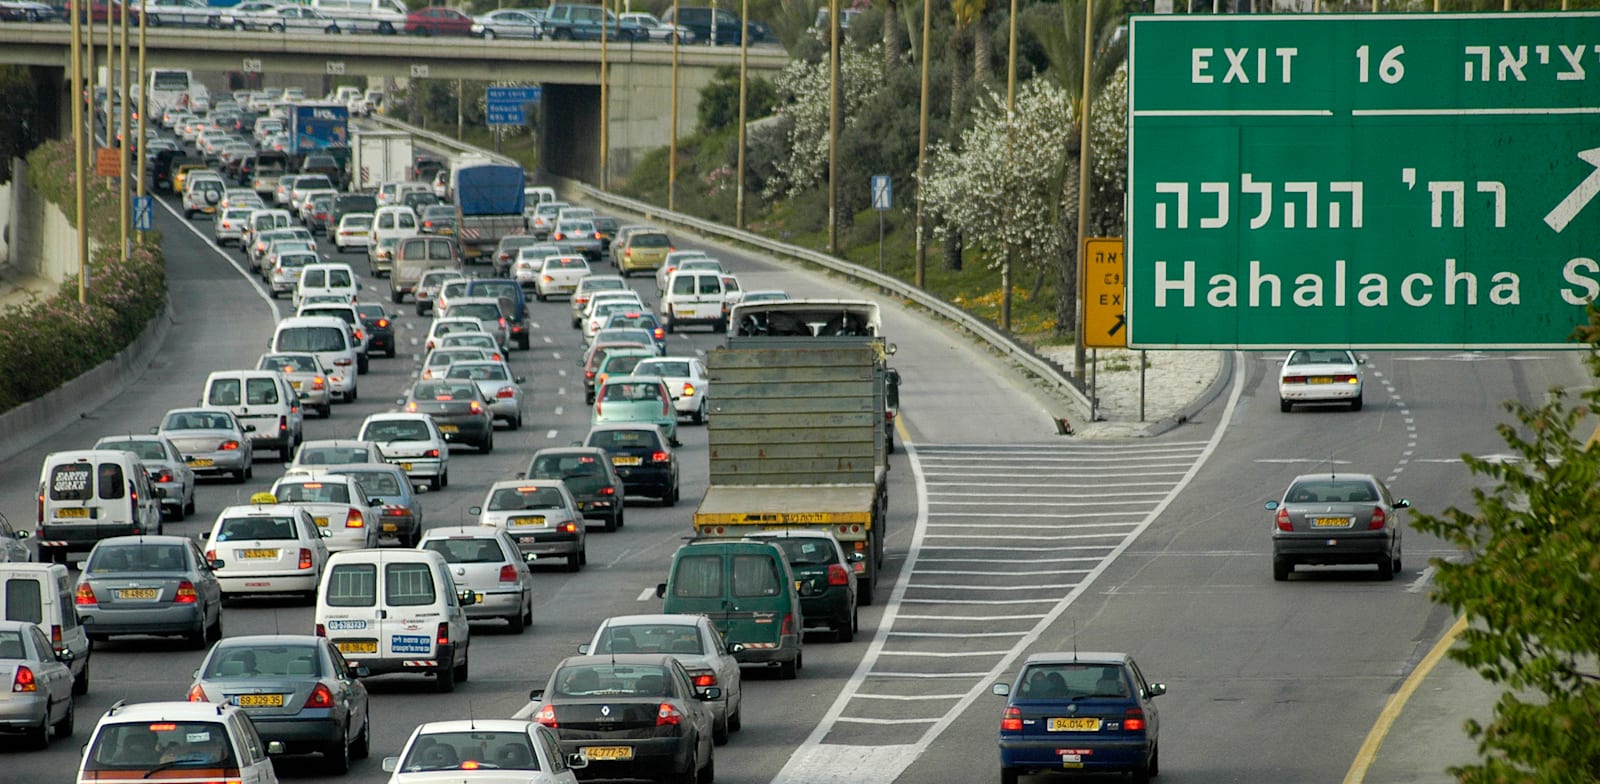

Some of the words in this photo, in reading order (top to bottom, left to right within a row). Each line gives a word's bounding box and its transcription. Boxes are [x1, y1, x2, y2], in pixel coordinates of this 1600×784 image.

[1192, 47, 1298, 84] EXIT
[1356, 45, 1405, 84] 16
[1155, 173, 1363, 229] ההלכה
[1402, 168, 1506, 228] רח'
[1155, 258, 1520, 308] Hahalacha
[55, 480, 87, 492] QUAKE
[57, 471, 89, 482] EARTH
